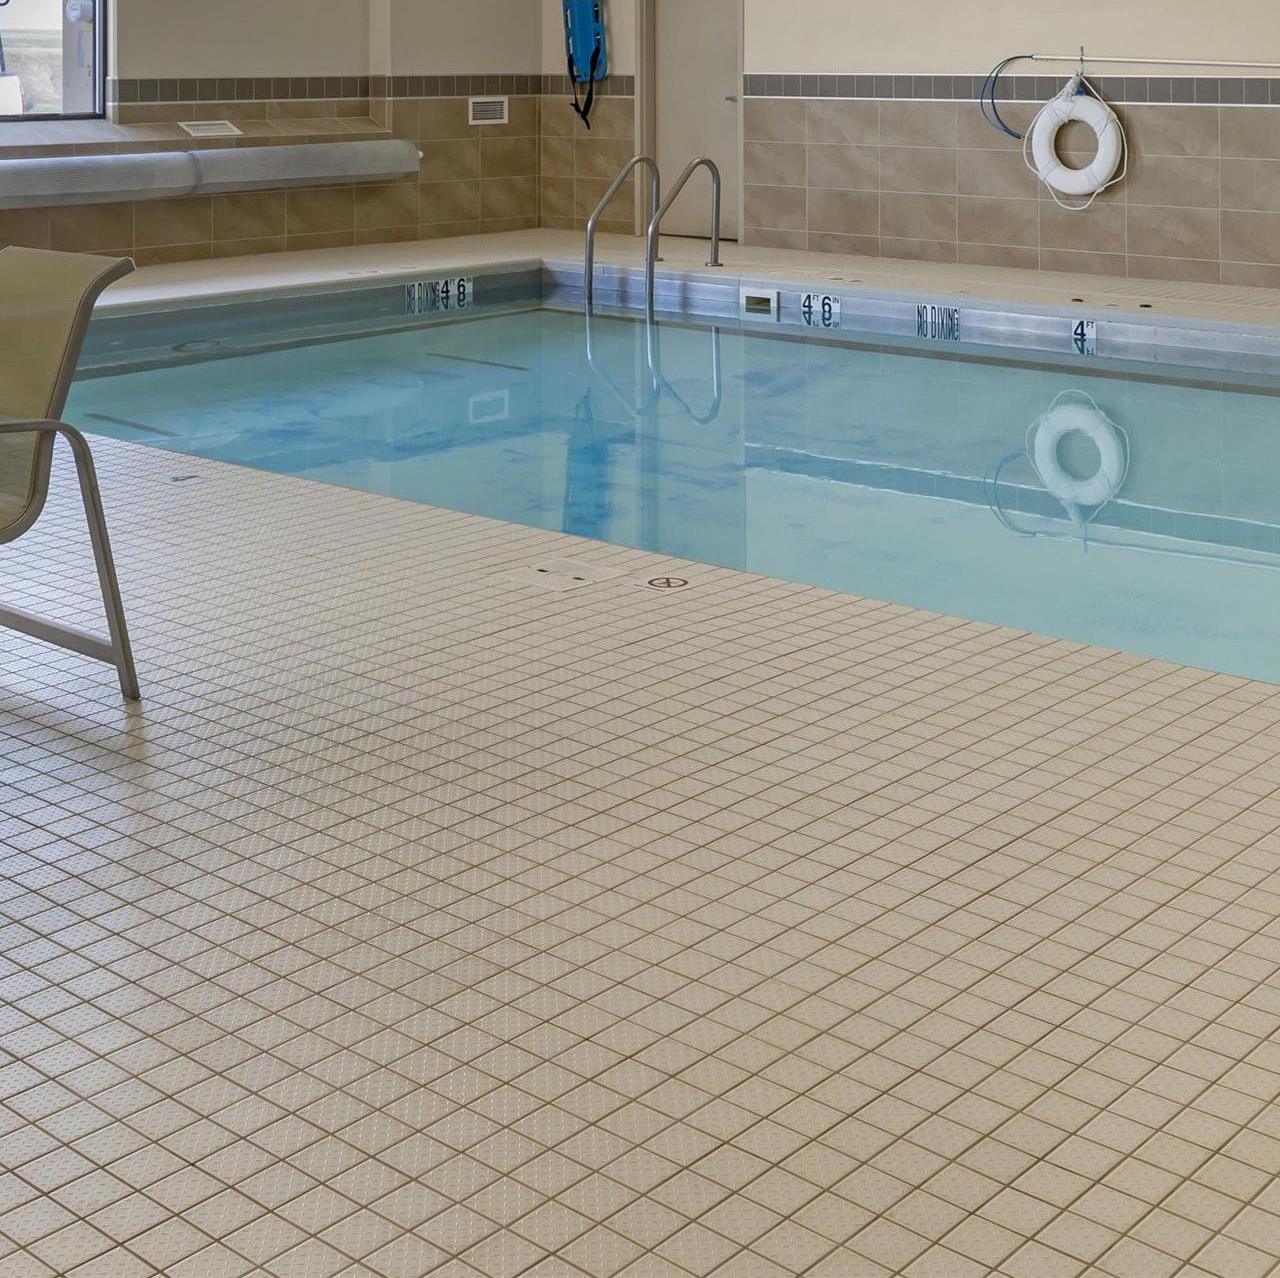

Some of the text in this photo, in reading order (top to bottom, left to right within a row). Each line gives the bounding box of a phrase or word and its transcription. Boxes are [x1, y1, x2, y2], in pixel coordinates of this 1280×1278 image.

[441, 279, 450, 296] 4
[802, 294, 813, 312] 4
[812, 294, 820, 302] FT
[821, 296, 832, 313] 6
[916, 304, 959, 325] NO DIVING
[1073, 320, 1094, 339] 4 FT
